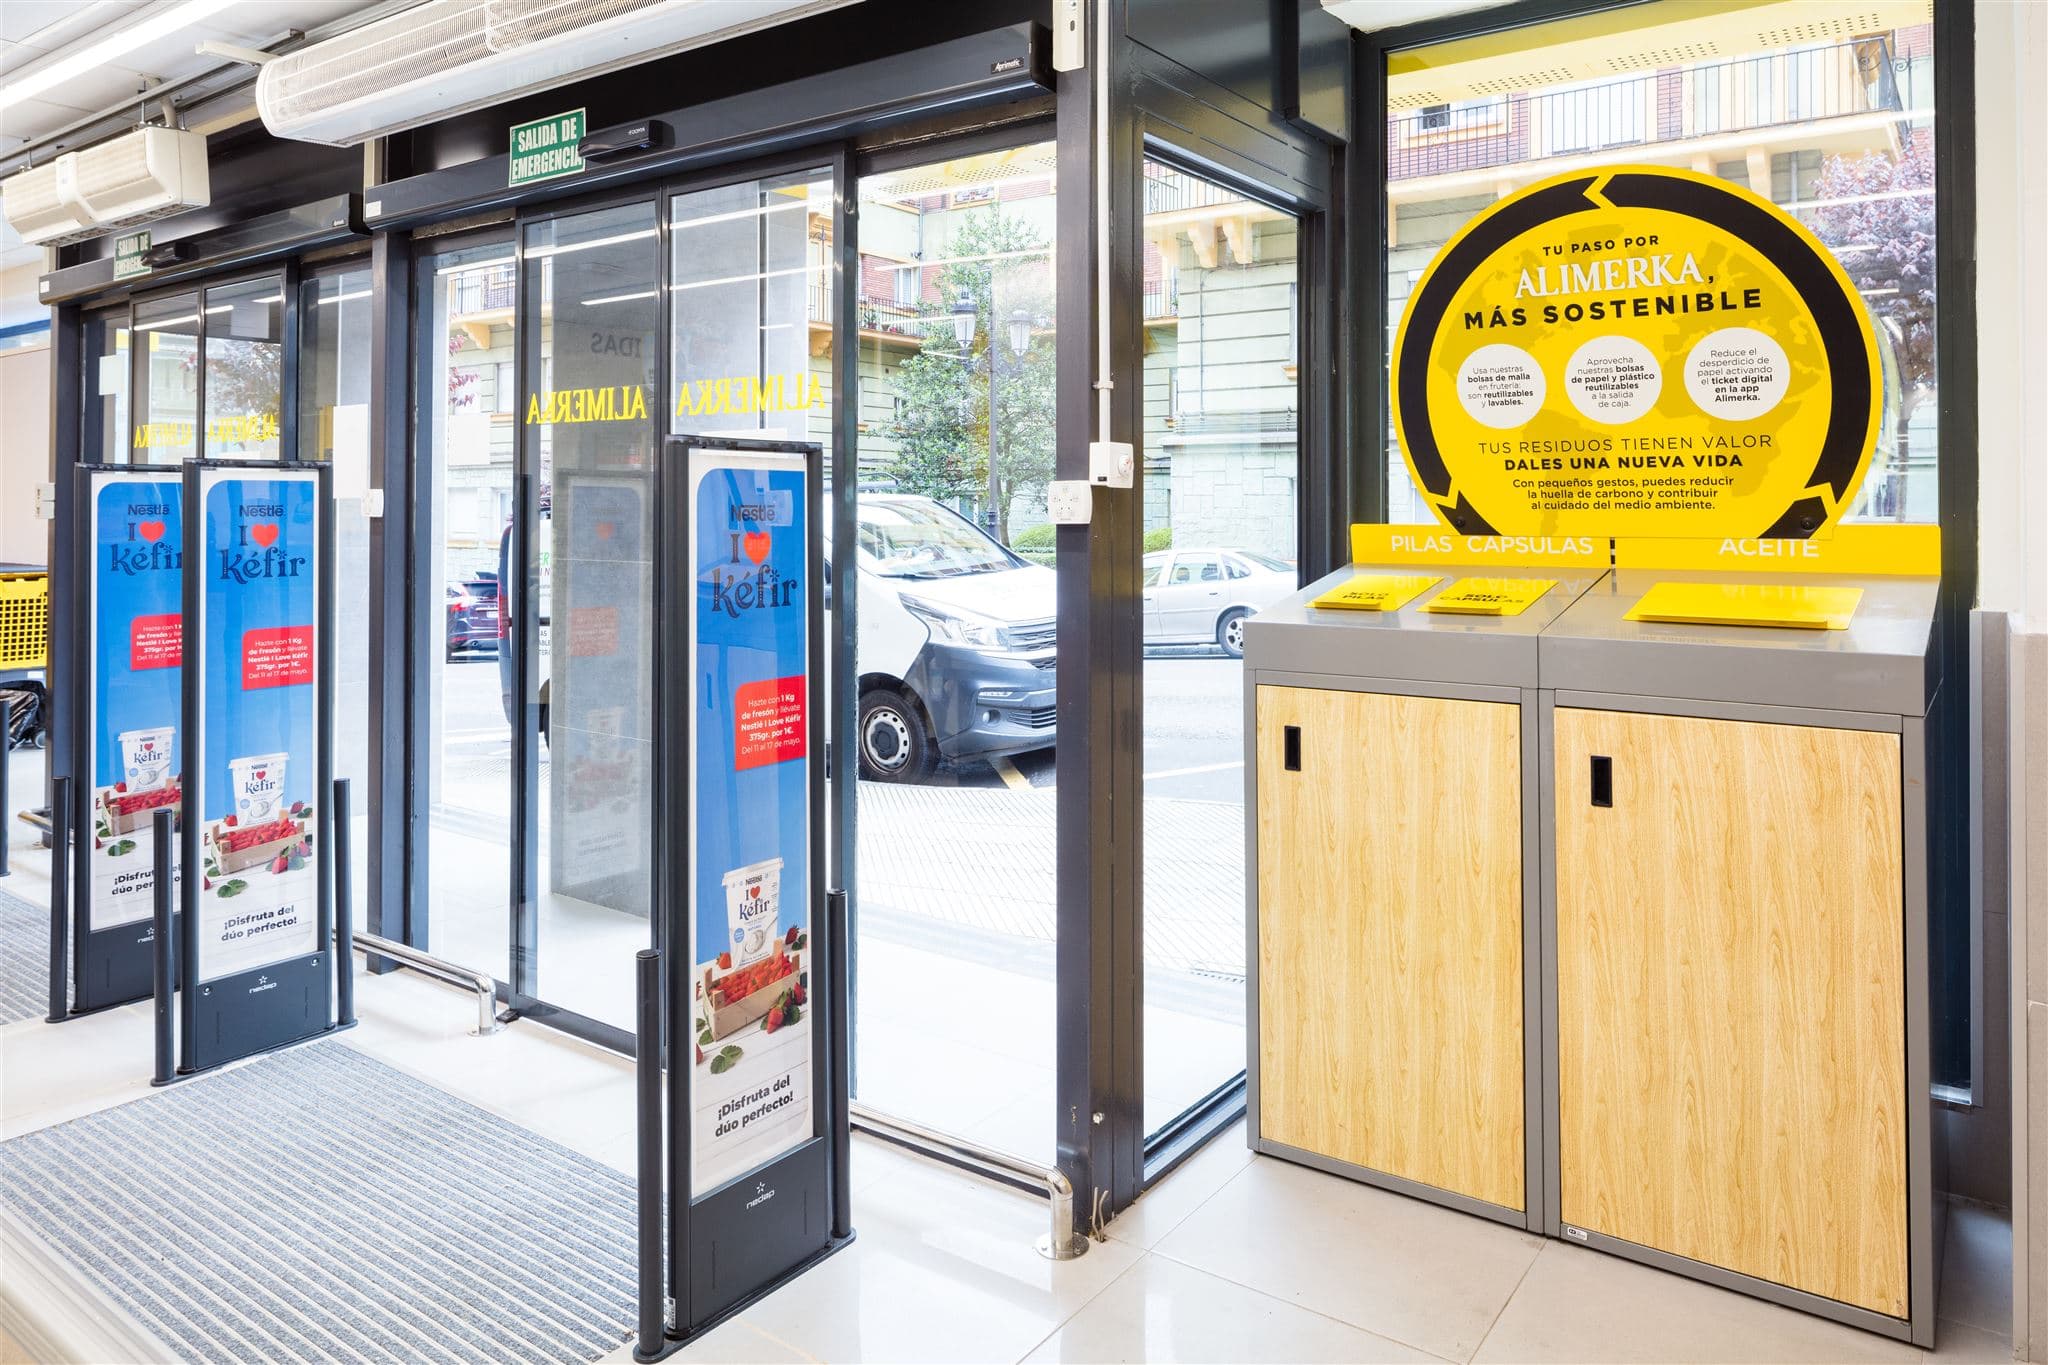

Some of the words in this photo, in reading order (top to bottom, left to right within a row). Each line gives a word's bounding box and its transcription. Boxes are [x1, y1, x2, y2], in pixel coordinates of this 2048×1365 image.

[518, 122, 558, 153] SALIDA
[561, 117, 577, 141] DE
[1543, 245, 1563, 256] TU
[1572, 239, 1616, 254] PASO
[1624, 235, 1660, 248] POR
[1514, 252, 1714, 299] ALIMERKA,
[1464, 305, 1527, 330] MÁS
[1543, 288, 1762, 324] SOSTENIBLE
[1710, 349, 1746, 358] Reduce
[1748, 348, 1758, 356] el
[1587, 356, 1634, 366] Aprovecha
[1699, 357, 1754, 368] desperdicio
[1756, 356, 1770, 364] de
[1472, 367, 1488, 375] Usa
[1489, 365, 1524, 374] nuestras
[1577, 366, 1614, 374] nuestras
[1616, 364, 1645, 373] bolsas
[1697, 367, 1724, 378] papel
[1725, 365, 1773, 376] activando
[1468, 375, 1494, 383] bolsas
[1496, 374, 1506, 382] de
[1508, 373, 1531, 381] malla
[1571, 376, 1582, 384] de
[1584, 374, 1610, 384] papel
[1611, 376, 1618, 384] y
[1619, 372, 1655, 384] plástico
[1701, 377, 1710, 386] el
[1712, 375, 1739, 385] ticket
[1740, 374, 1773, 385] digital
[1585, 382, 1639, 392] reutilizables
[1714, 386, 1727, 394] en
[1729, 384, 1738, 393] la
[1740, 385, 1760, 395] app
[1484, 389, 1534, 399] reutilizables
[1599, 392, 1607, 400] la
[1608, 390, 1634, 400] salida
[1714, 393, 1761, 403] Alimerka.
[1481, 400, 1487, 408] y
[1488, 398, 1524, 406] lavables.
[1598, 400, 1609, 408] de
[1611, 400, 1631, 409] caja.
[1478, 441, 1512, 455] TUS
[1519, 438, 1613, 454] RESIDUOS
[1621, 436, 1694, 452] TIENEN
[1701, 434, 1773, 449] VALOR
[1504, 457, 1563, 472] DALES
[1570, 456, 1611, 470] UNA
[1618, 455, 1685, 469] NUEVA
[1692, 454, 1744, 468] VIDA
[1512, 478, 1535, 489] Con
[1537, 476, 1594, 491] pequeños
[1596, 477, 1639, 490] gestos,
[1642, 476, 1686, 489] puedes
[1689, 475, 1735, 487] reducir
[1528, 490, 1538, 500] la
[1540, 488, 1575, 499] huella
[1576, 488, 1592, 499] de
[1595, 488, 1644, 499] carbono
[1646, 490, 1655, 501] y
[1658, 486, 1719, 499] contribuir
[1530, 500, 1541, 510] al
[1544, 500, 1590, 510] cuidado
[1592, 500, 1612, 510] del
[1614, 499, 1652, 510] medio
[1655, 498, 1716, 510] ambiente.
[238, 525, 248, 546] I
[730, 533, 740, 564] I
[1391, 534, 1453, 554] PILAS
[1467, 535, 1594, 555] CAPSULAS
[1718, 538, 1820, 558] ACEITE
[114, 870, 154, 885] ¡Disfrut
[112, 886, 132, 896] dúo
[224, 908, 274, 930] ¡Disfruta
[278, 904, 294, 916] del
[221, 928, 244, 942] dúo
[247, 916, 298, 937] perfecto!
[718, 1086, 770, 1120] ¡Disfruta
[772, 1074, 790, 1092] del
[715, 1119, 739, 1137] dúo
[742, 1090, 794, 1128] perfecto!
